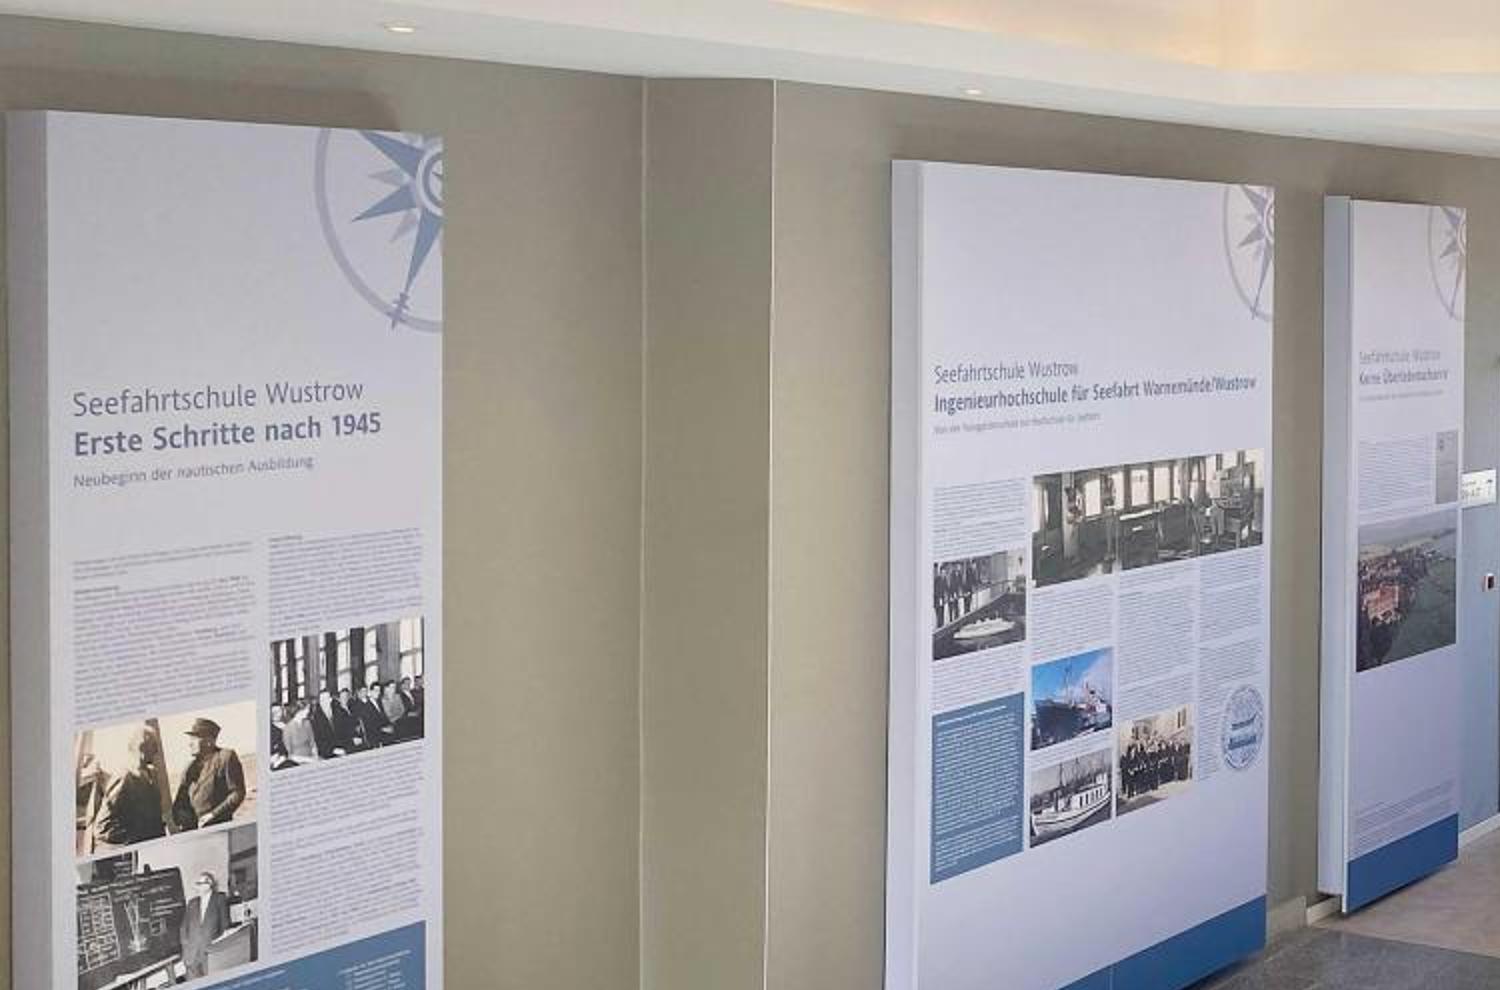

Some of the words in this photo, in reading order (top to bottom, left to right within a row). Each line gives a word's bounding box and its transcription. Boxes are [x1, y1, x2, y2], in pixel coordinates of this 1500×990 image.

[934, 362, 1025, 384] Seefahrtschule
[73, 383, 257, 417] Seefahrtschule
[265, 381, 364, 405] Wustrow
[934, 386, 1068, 416] Ingenieurhochschule
[1071, 384, 1089, 401] für
[1092, 379, 1140, 400] Seefahrt
[75, 431, 143, 457] Erste
[153, 423, 256, 451] Schritte
[265, 416, 322, 442] nach
[332, 412, 381, 436] 1945
[151, 468, 173, 481] der
